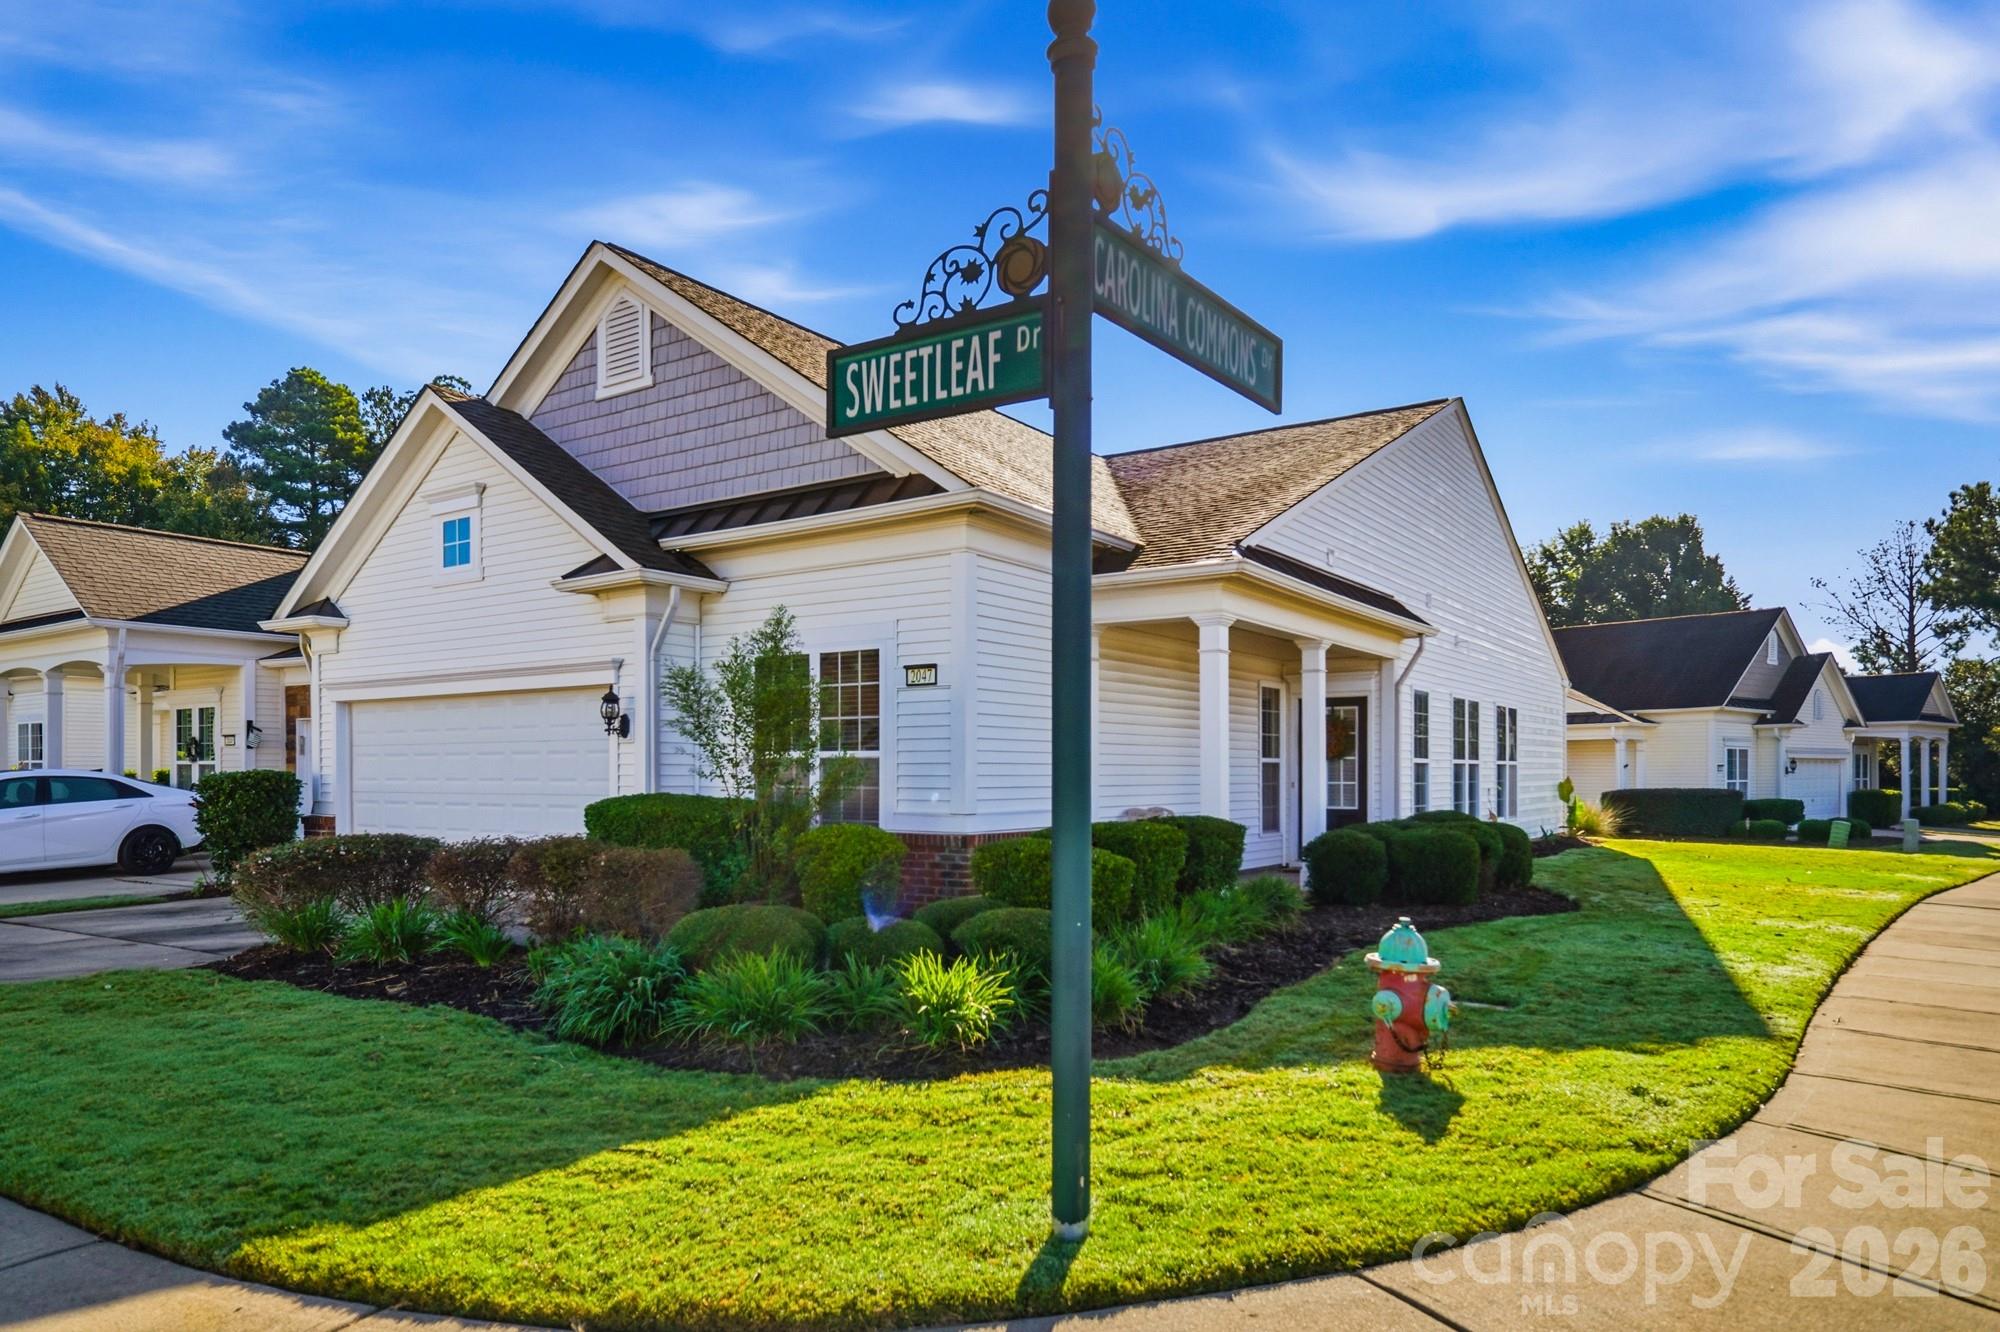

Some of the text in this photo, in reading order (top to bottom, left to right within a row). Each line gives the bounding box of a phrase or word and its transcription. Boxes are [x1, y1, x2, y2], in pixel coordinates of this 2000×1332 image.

[1094, 236, 1179, 340] CAROLINA
[1186, 297, 1257, 385] COMMONS
[846, 325, 1041, 418] SWEETLEAF Dr
[911, 668, 933, 683] 2047
